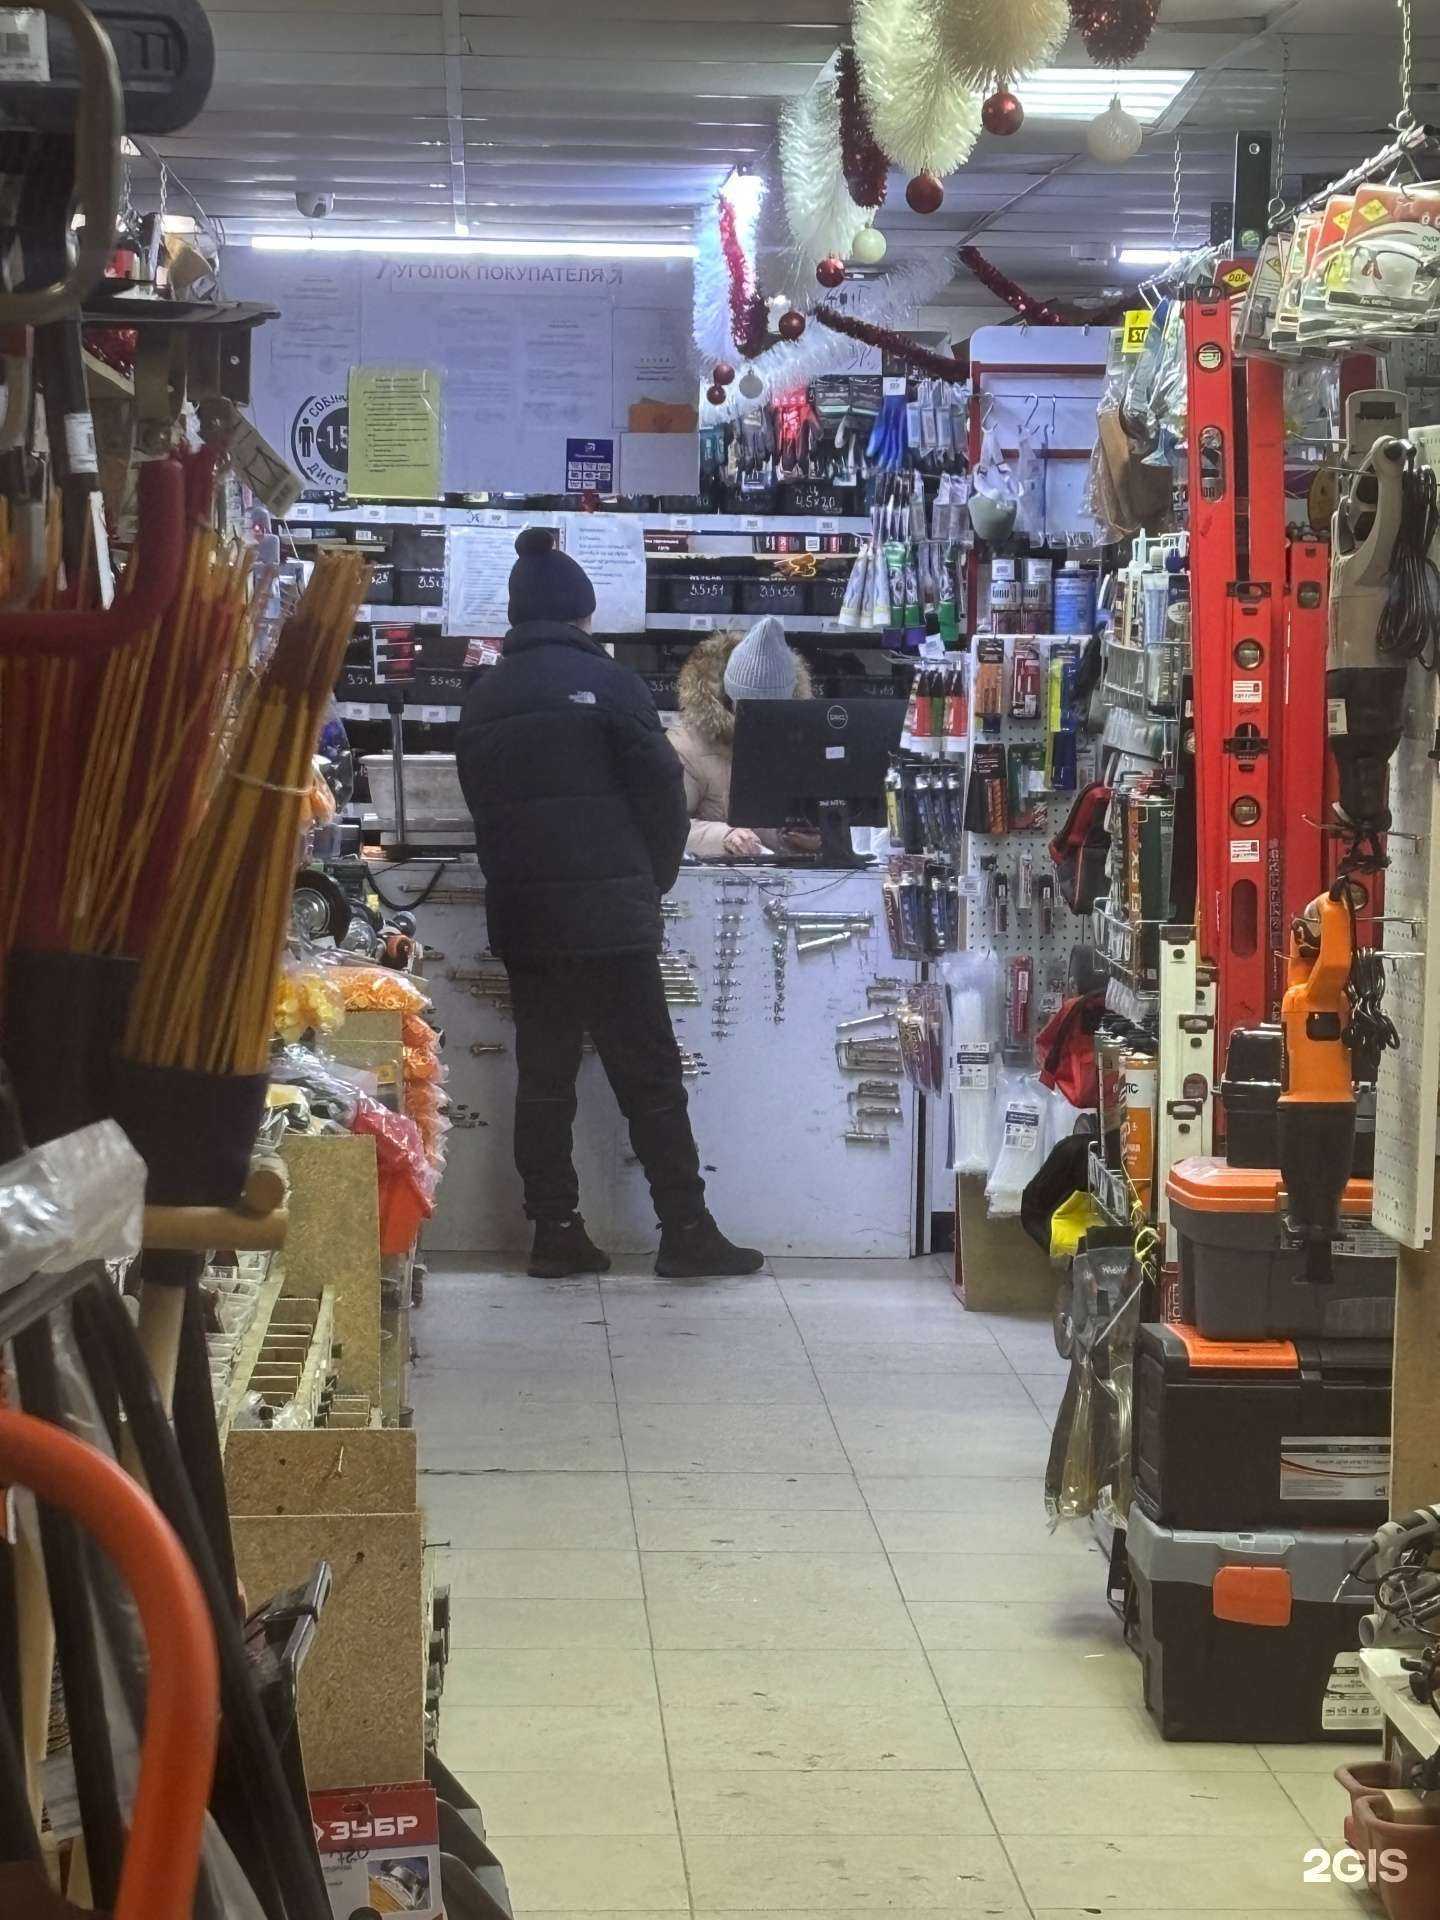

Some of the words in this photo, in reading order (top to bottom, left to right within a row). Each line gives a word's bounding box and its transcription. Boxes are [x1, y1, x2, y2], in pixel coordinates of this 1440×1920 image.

[396, 264, 471, 280] УГОЛОК
[476, 265, 604, 283] ПОКУПАТЕЛЯ
[329, 1815, 418, 1841] ЗУБР
